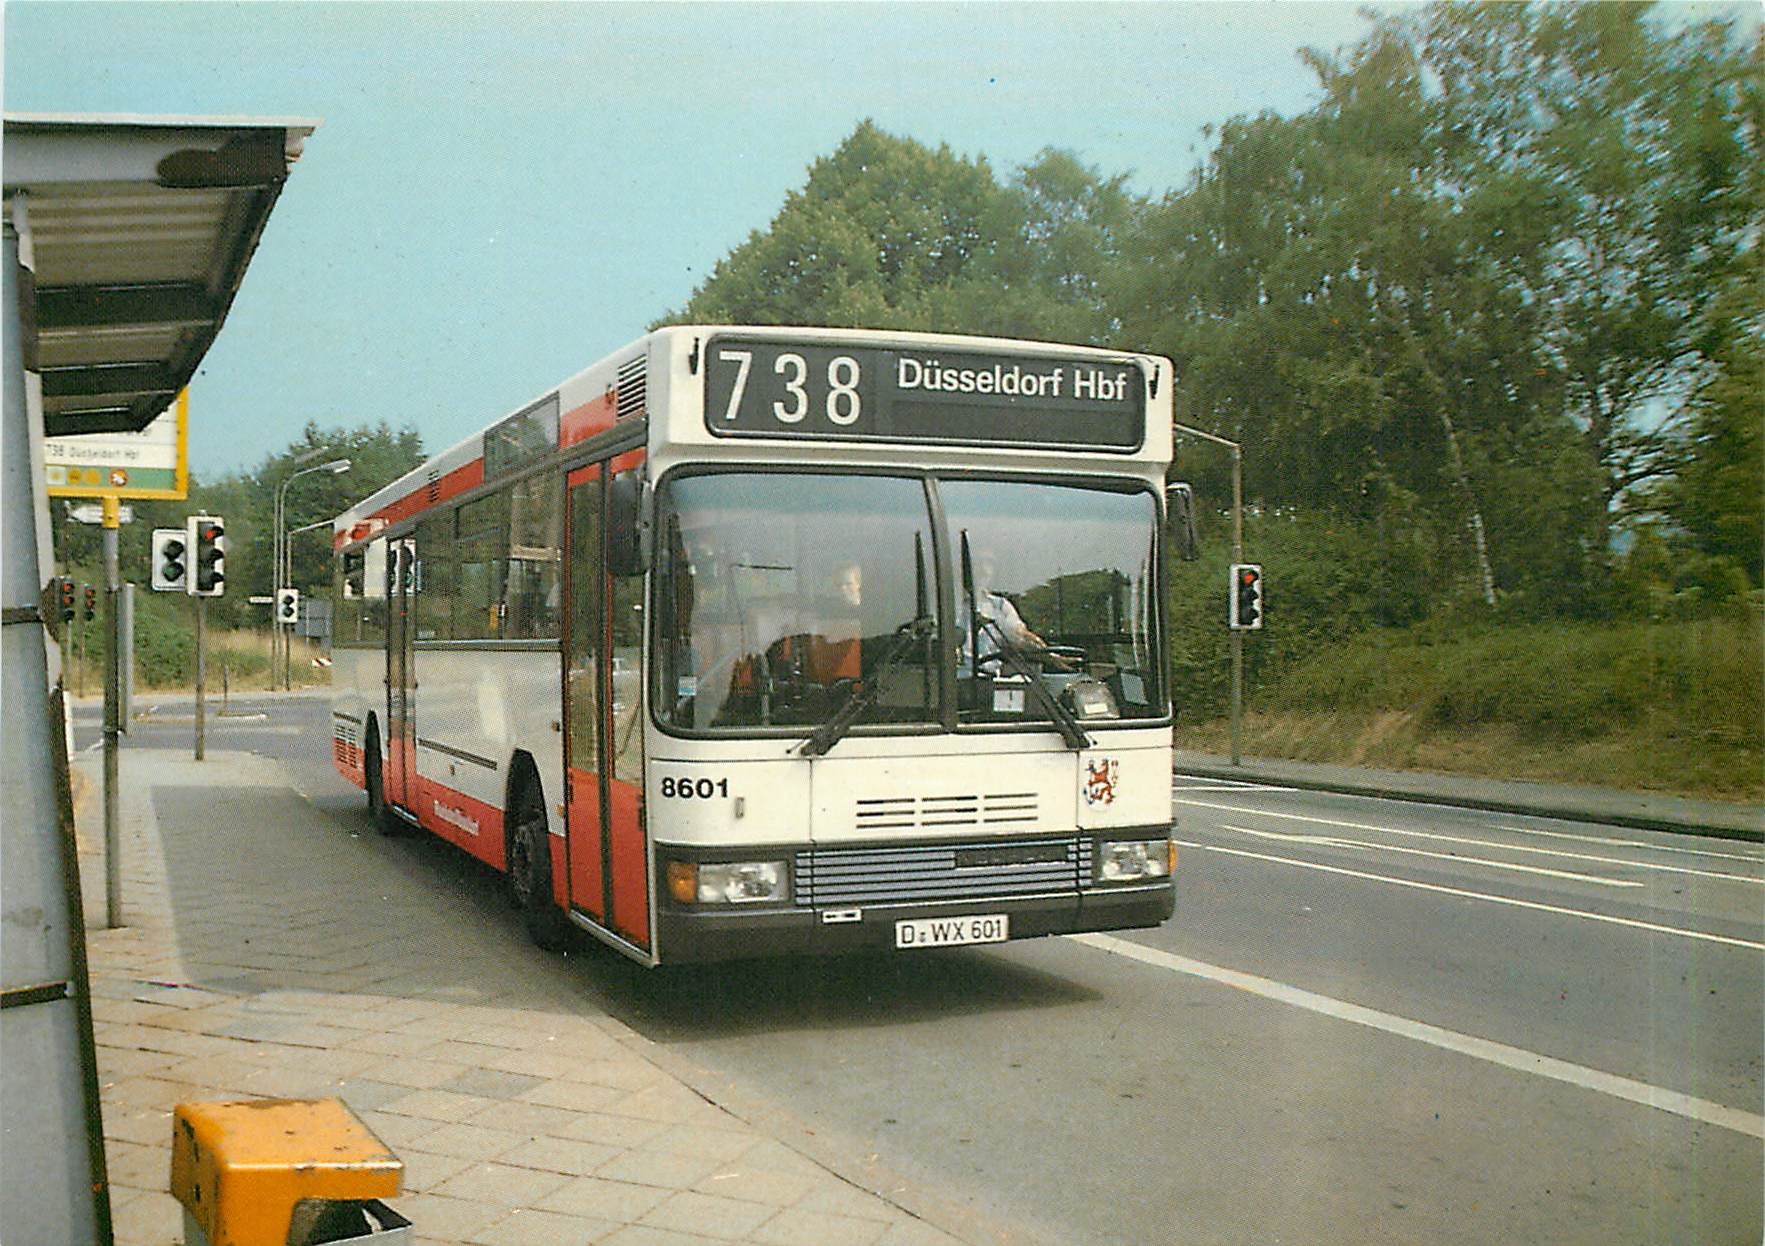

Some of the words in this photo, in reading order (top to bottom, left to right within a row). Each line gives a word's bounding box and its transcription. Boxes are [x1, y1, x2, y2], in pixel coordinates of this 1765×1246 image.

[718, 350, 862, 426] 738
[898, 357, 1064, 397] Düsseldorf
[1073, 369, 1128, 400] Hbf
[661, 776, 728, 799] 8601
[901, 924, 915, 944] D
[931, 921, 965, 942] WX
[970, 919, 1002, 939] 601
